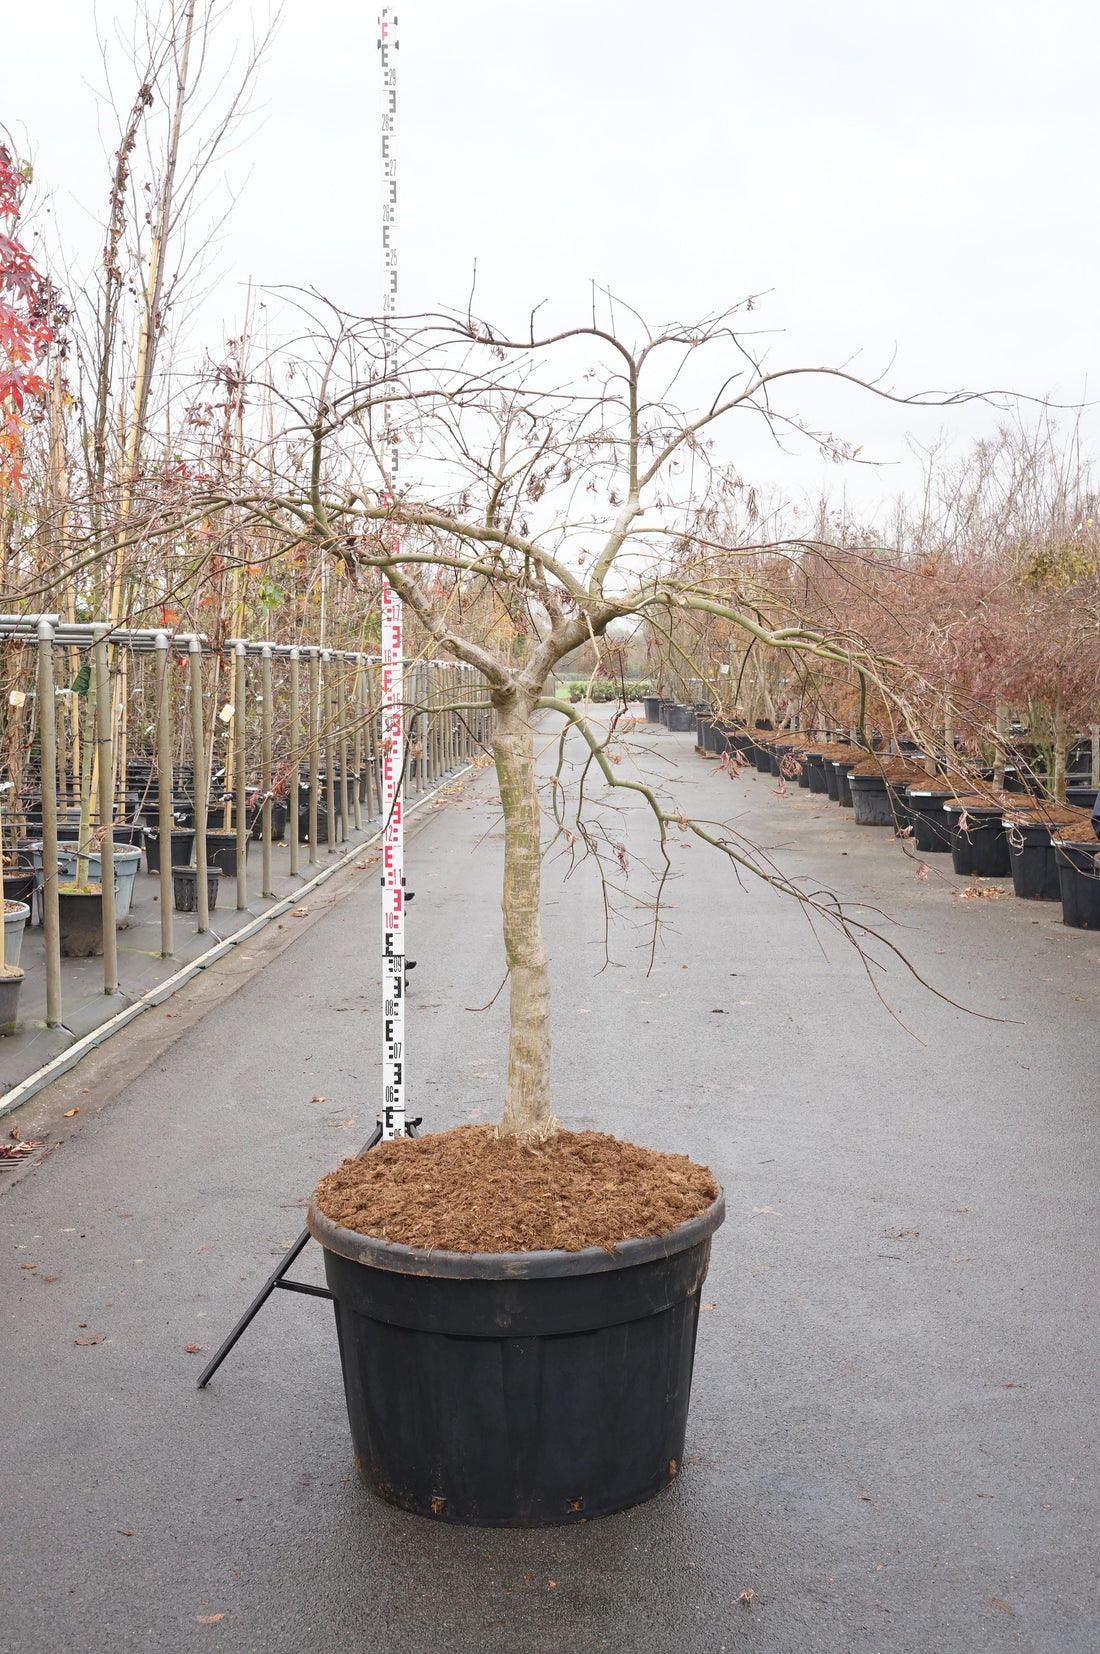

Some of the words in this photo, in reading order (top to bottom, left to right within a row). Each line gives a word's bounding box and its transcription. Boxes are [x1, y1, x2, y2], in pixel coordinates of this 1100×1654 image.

[392, 604, 400, 621] 17
[385, 912, 394, 929] 10
[385, 1000, 394, 1016] 08
[394, 1042, 402, 1059] 07
[385, 1086, 394, 1102] 06
